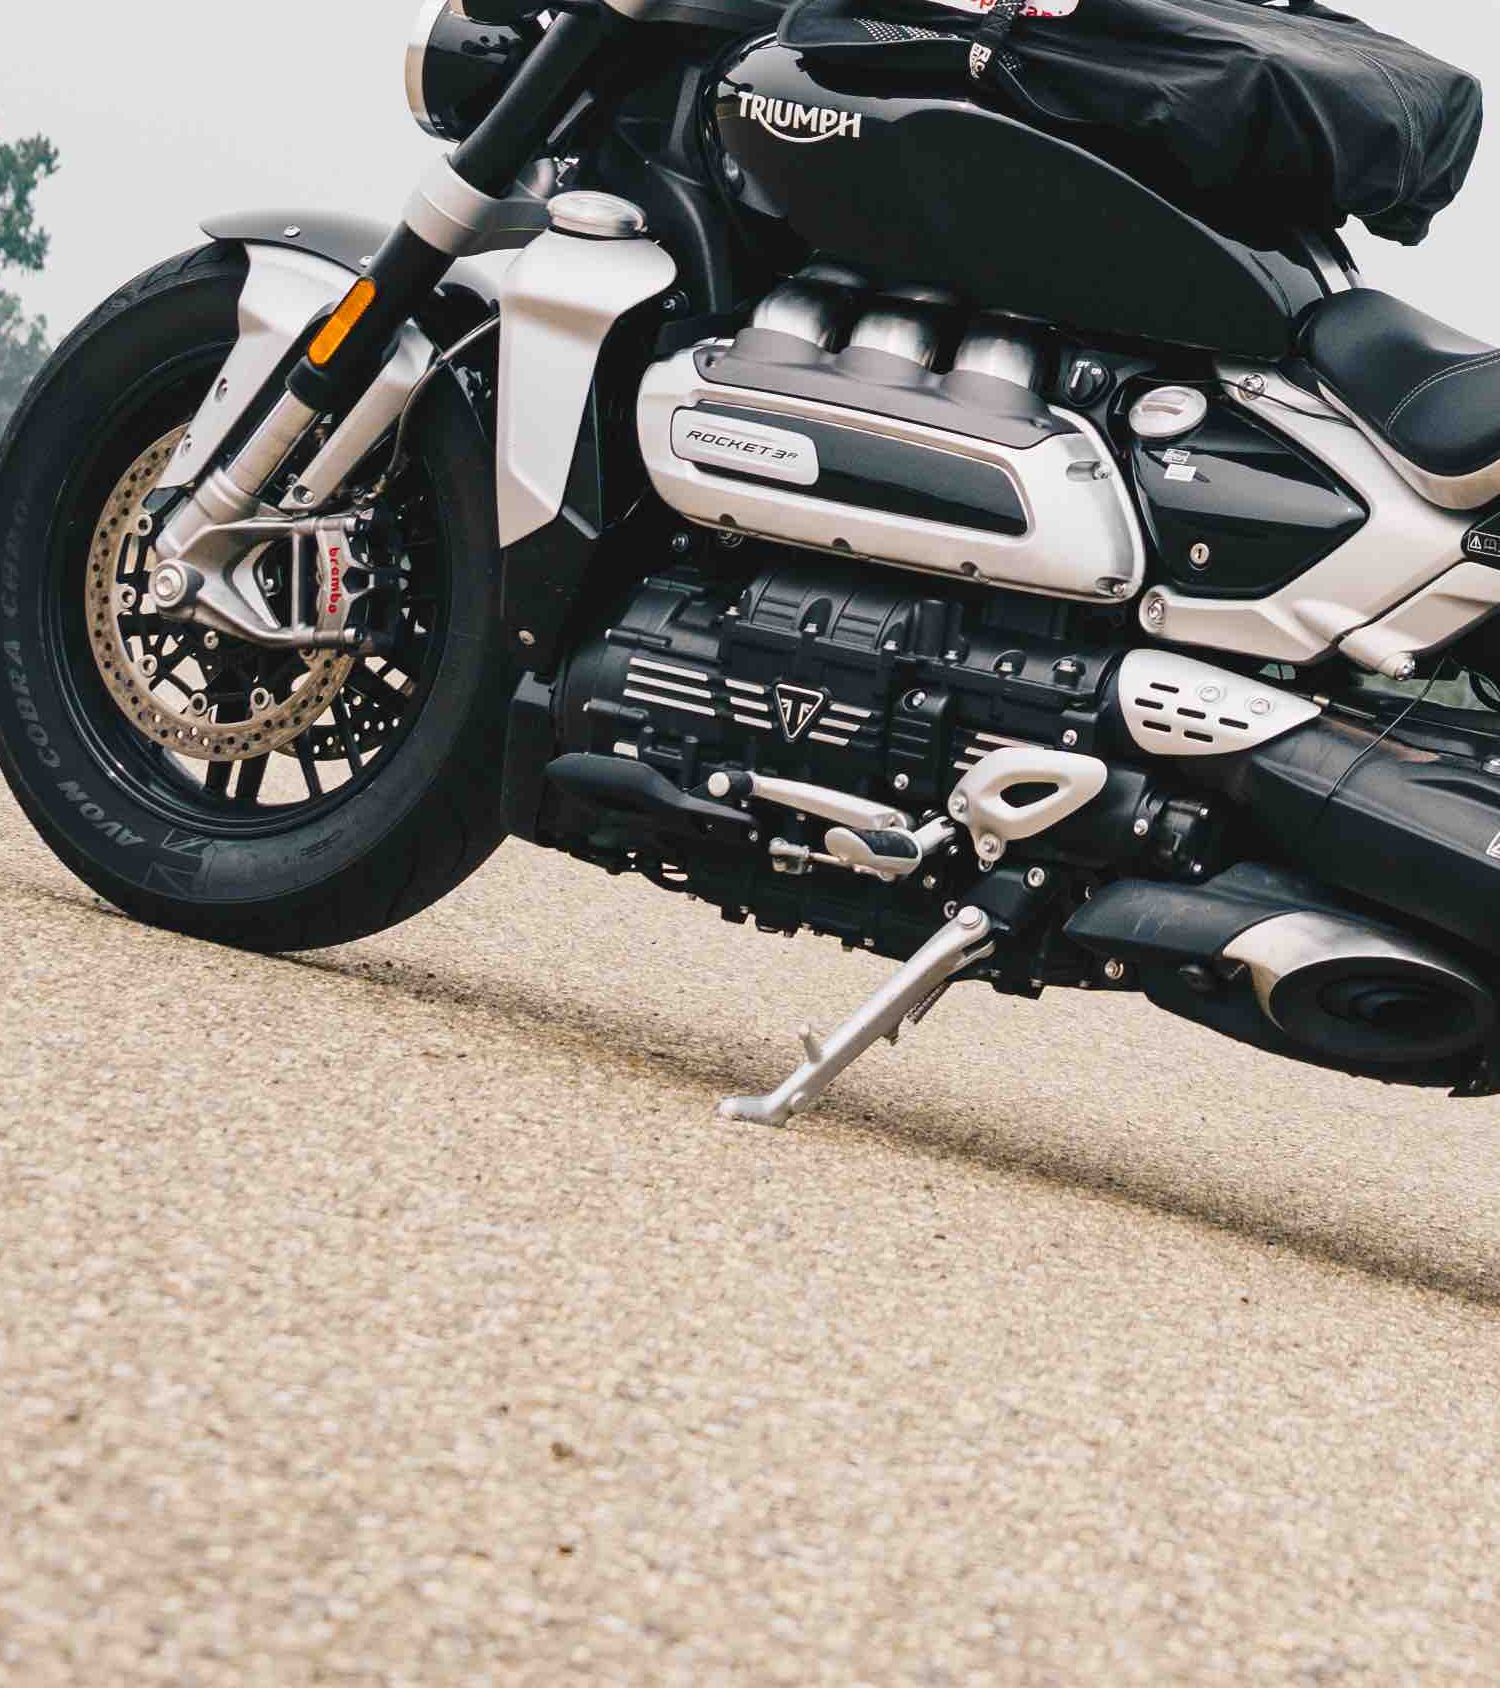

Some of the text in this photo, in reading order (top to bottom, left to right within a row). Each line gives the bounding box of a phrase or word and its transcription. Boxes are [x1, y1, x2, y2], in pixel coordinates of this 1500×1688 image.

[738, 92, 861, 142] TRIUMPH
[686, 430, 772, 458] ROCKET
[328, 546, 342, 614] brembo
[3, 639, 61, 768] COBRA
[56, 779, 147, 847] AVON
